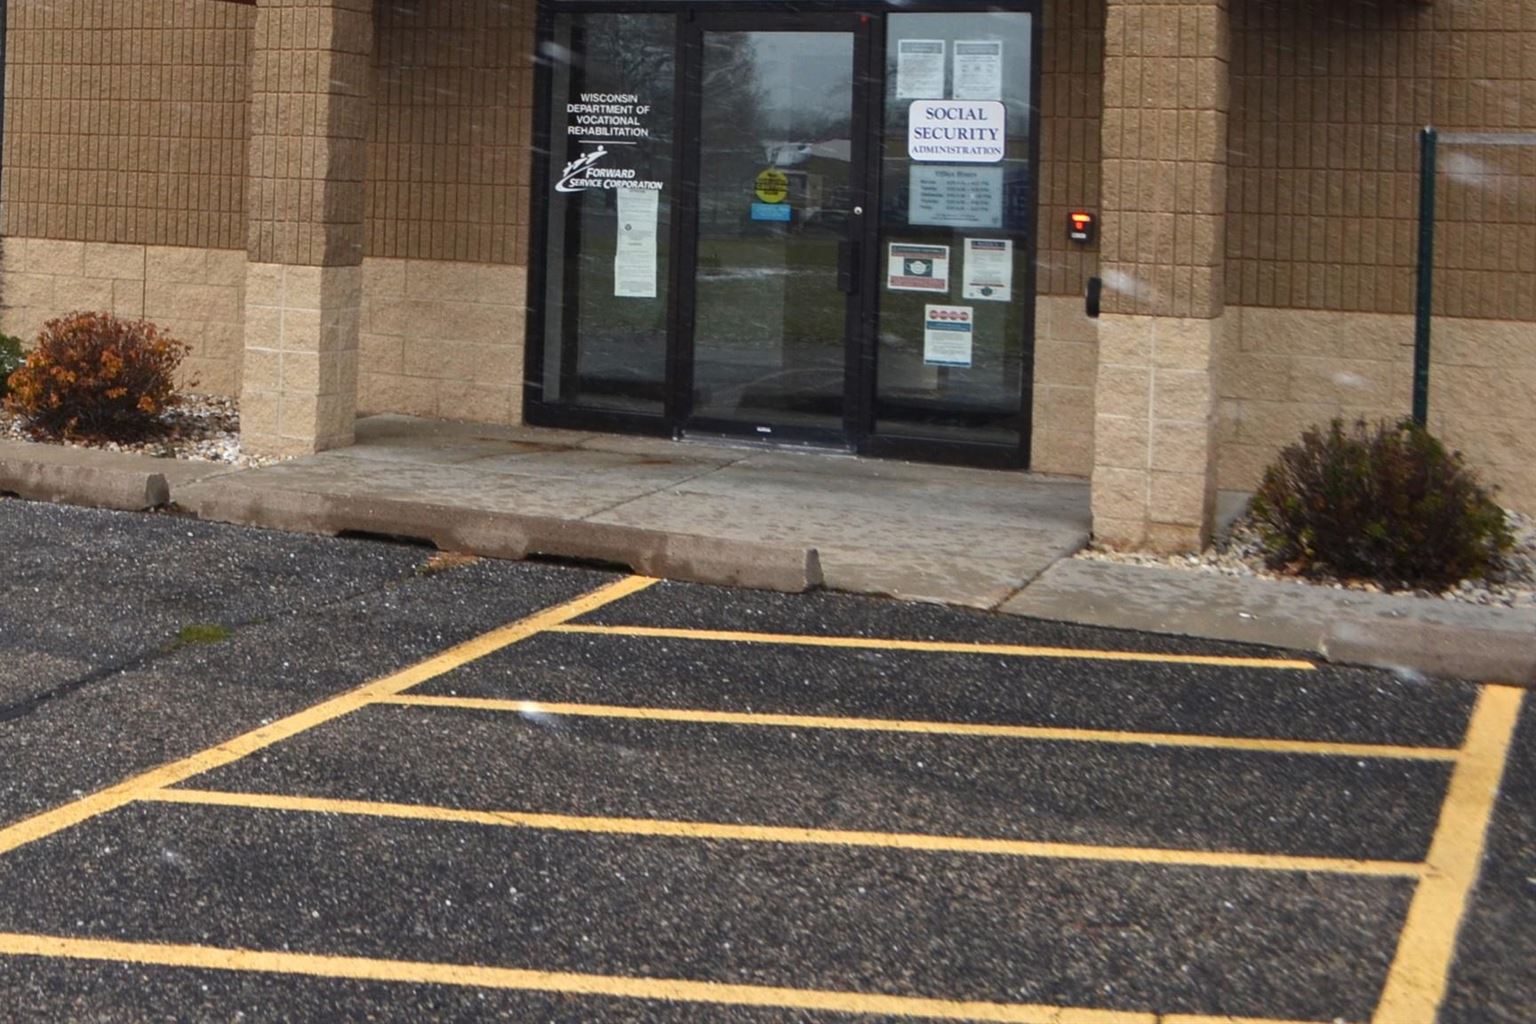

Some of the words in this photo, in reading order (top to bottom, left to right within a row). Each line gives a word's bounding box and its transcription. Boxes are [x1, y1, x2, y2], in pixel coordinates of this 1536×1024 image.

[580, 93, 638, 103] WISCONSIN
[566, 103, 633, 114] DEPARTMENT
[635, 105, 651, 115] OF
[925, 107, 988, 121] SOCIAL
[576, 115, 640, 125] VOCATIONAL
[567, 126, 649, 136] REHABILITATION
[913, 126, 999, 141] SECURITY
[911, 145, 1001, 155] ADMINISTRATION
[585, 168, 636, 178] FORWARD
[568, 178, 602, 188] SERVICE
[603, 179, 663, 190] CORPORATION
